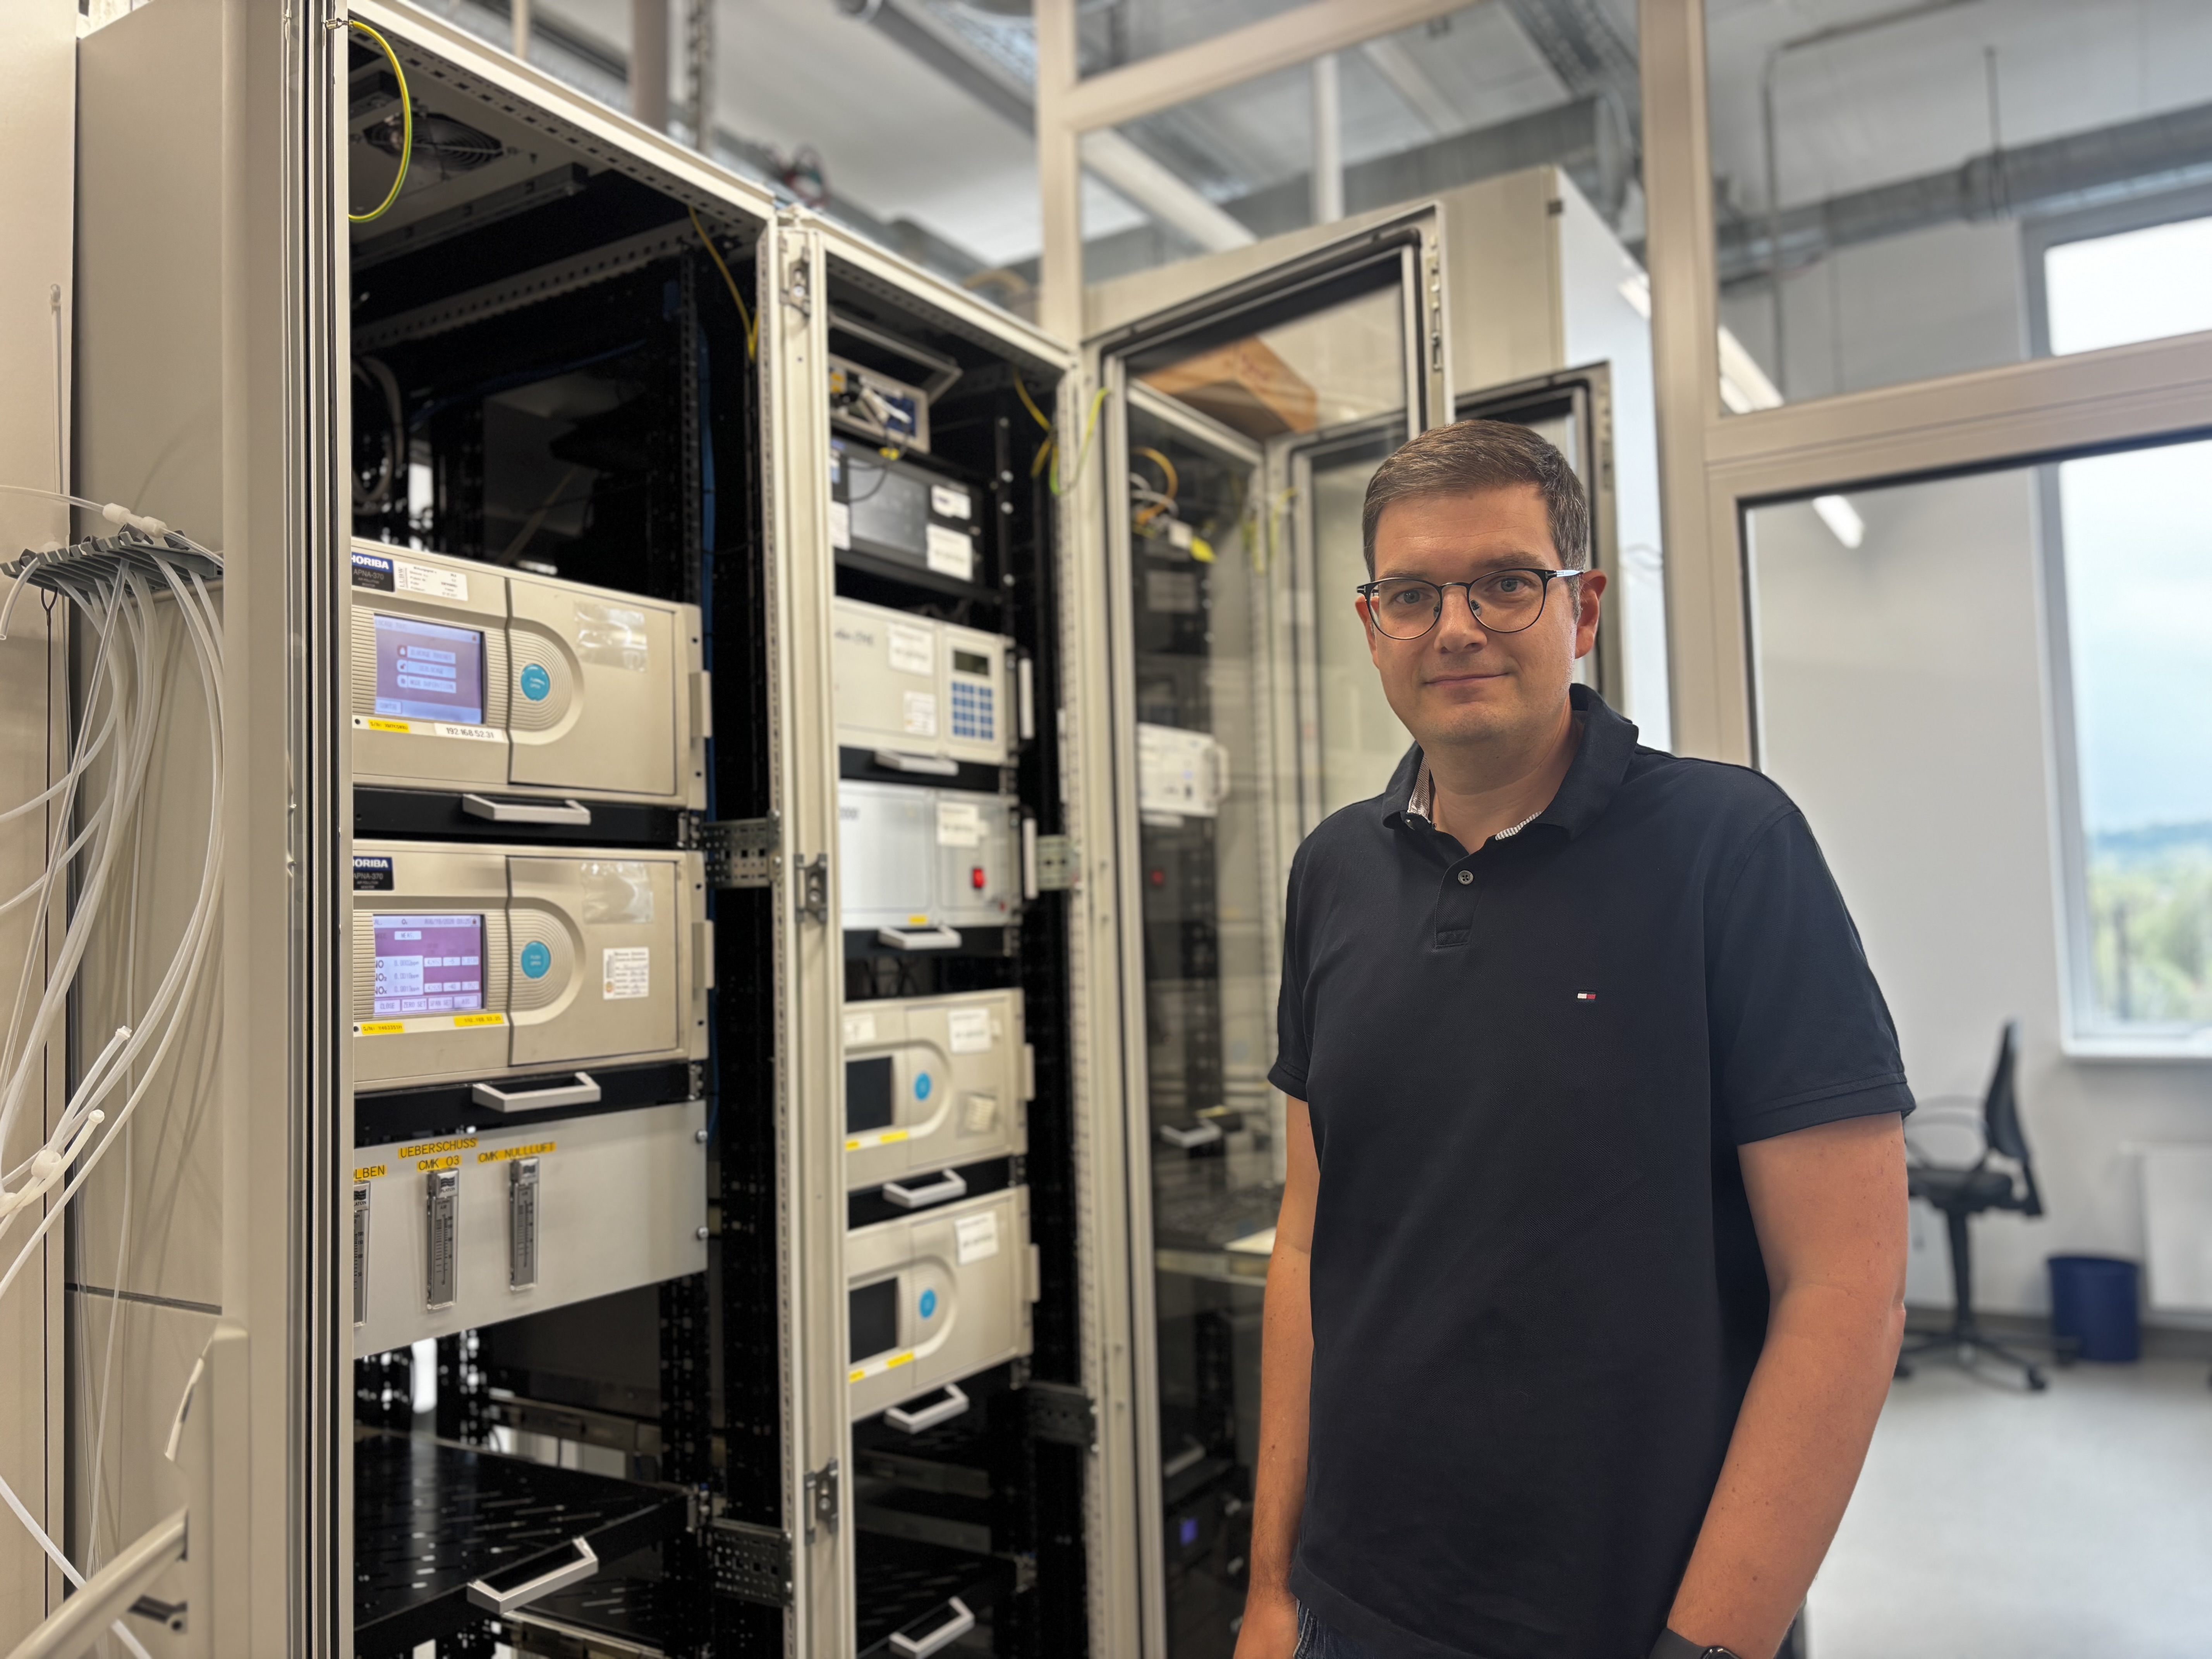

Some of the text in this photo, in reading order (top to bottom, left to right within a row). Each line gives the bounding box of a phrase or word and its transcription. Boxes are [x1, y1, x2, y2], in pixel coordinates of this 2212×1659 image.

[353, 568, 385, 580] APNA-370
[400, 1137, 477, 1158] UEBERSCHUSS
[479, 1150, 498, 1163] CMK
[419, 1158, 439, 1171] CMK
[354, 1164, 385, 1180] LBEN
